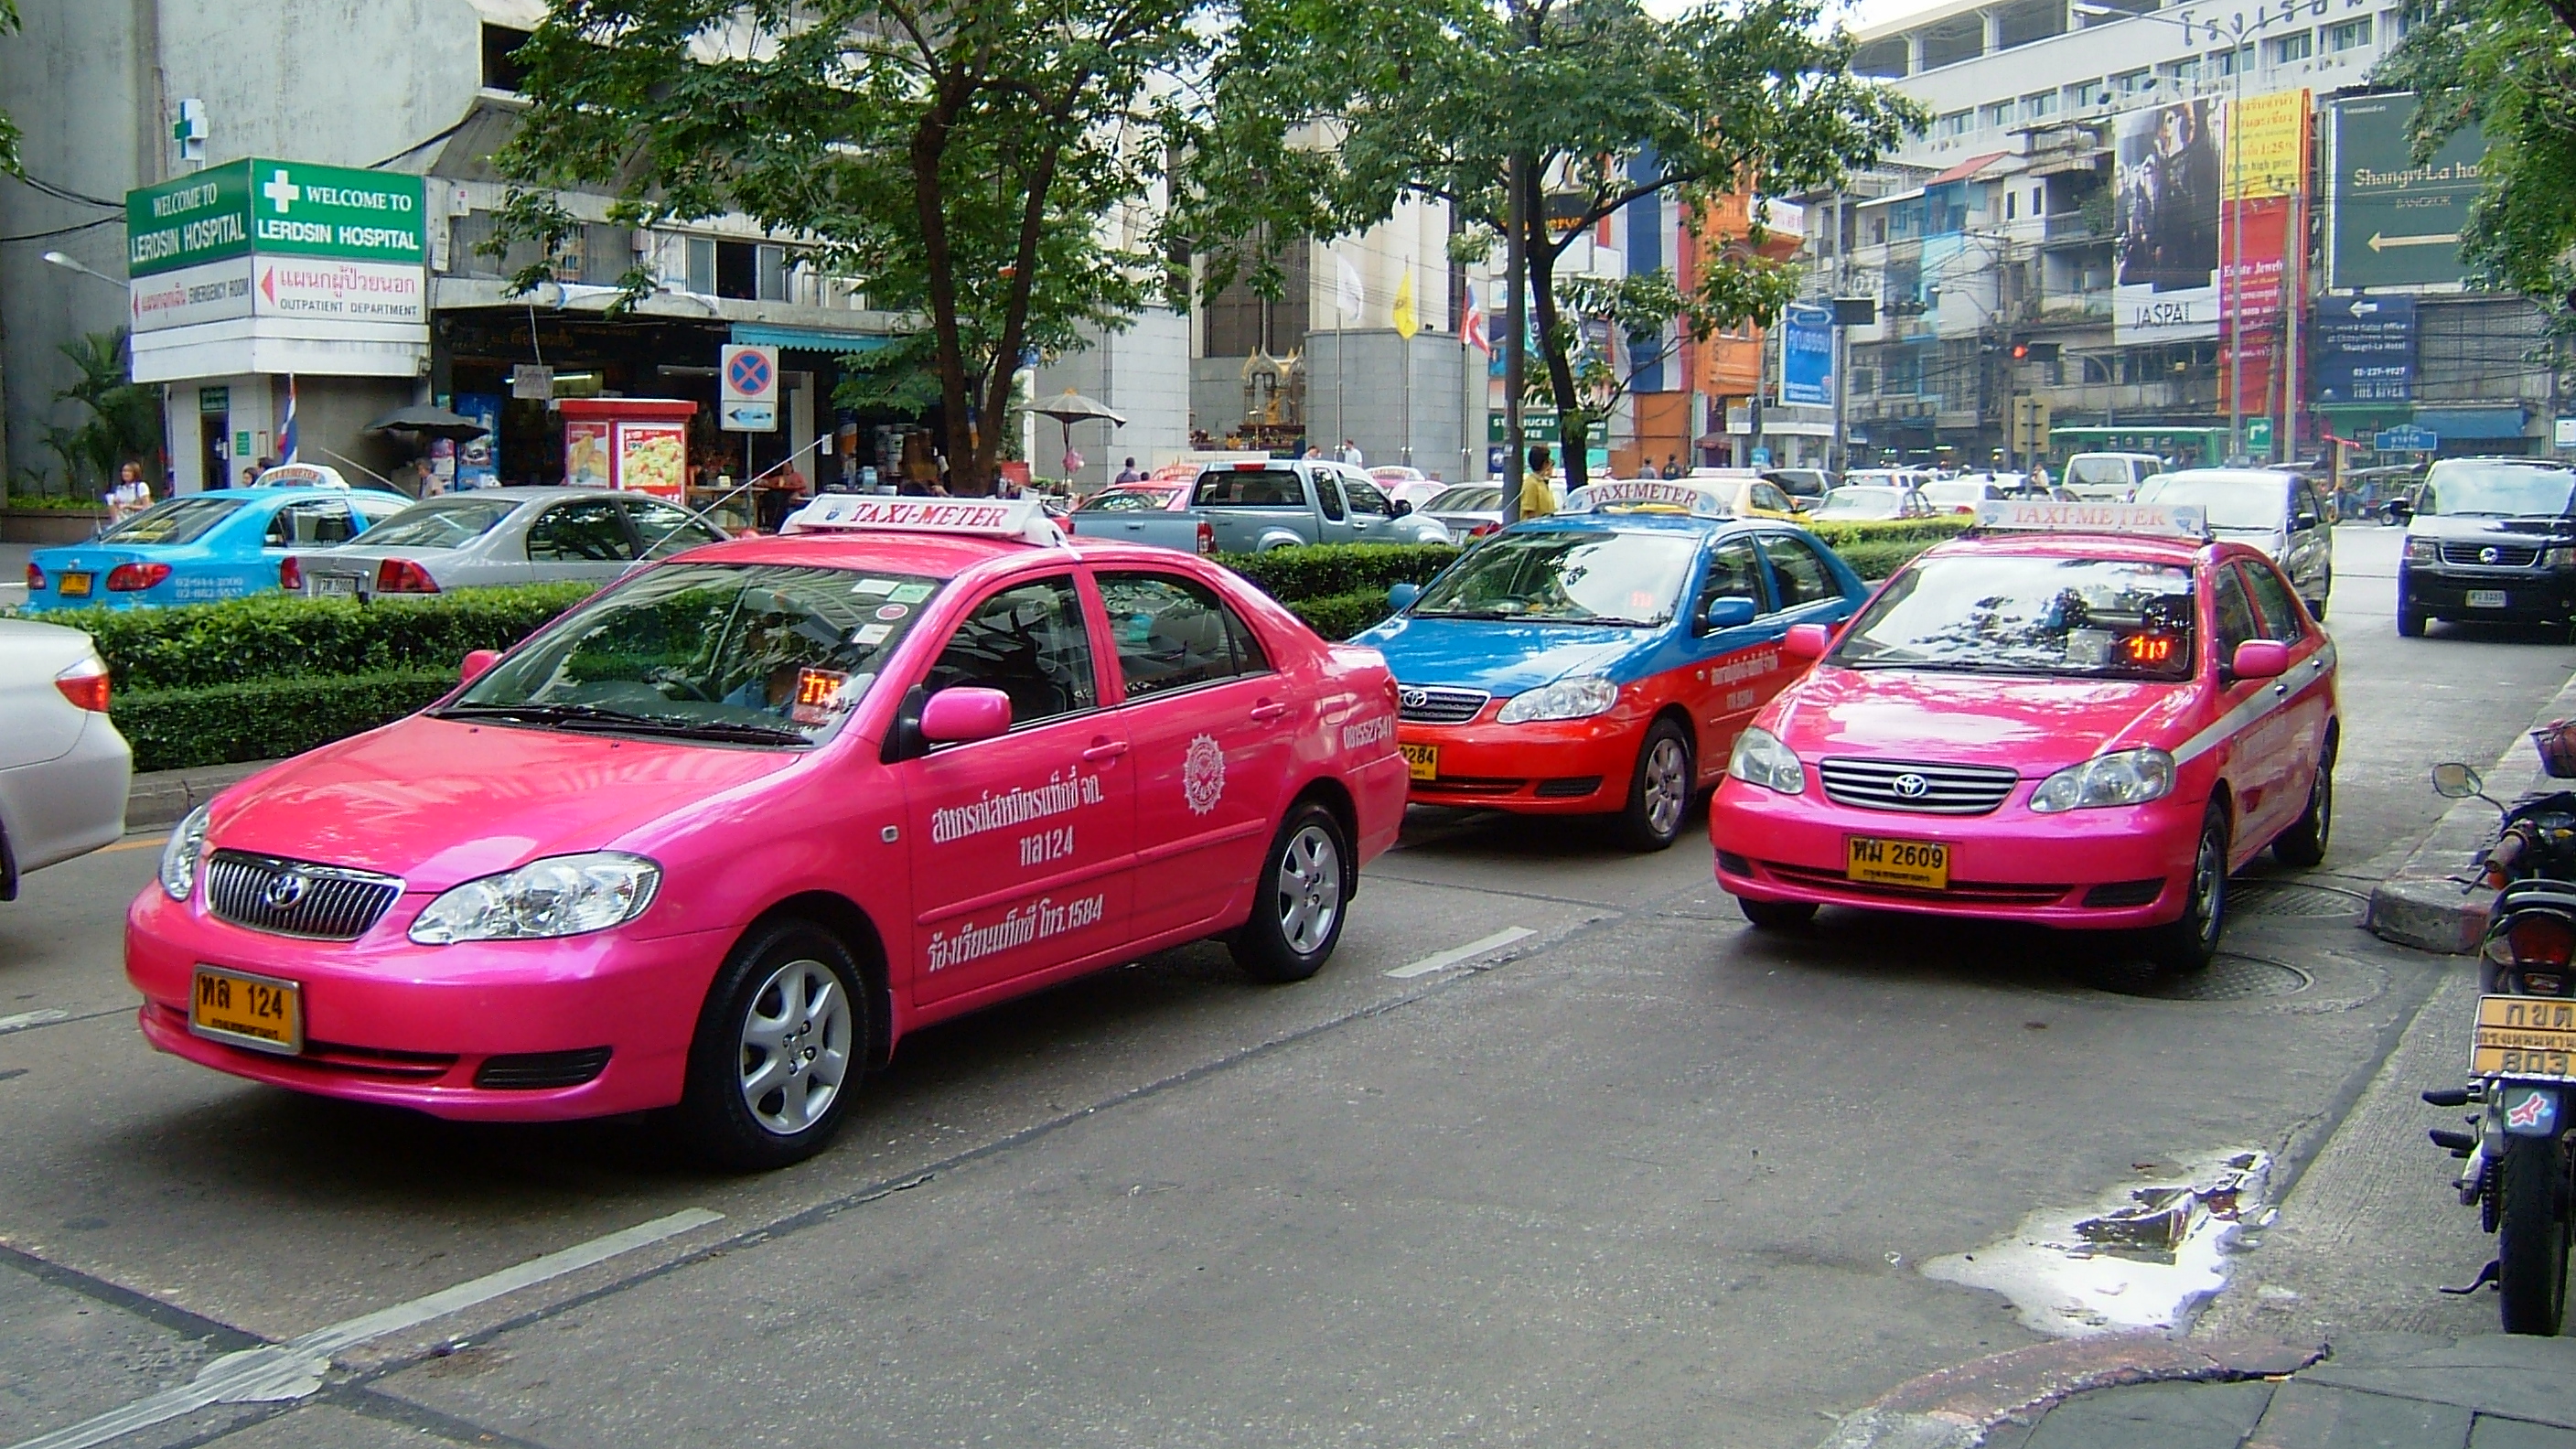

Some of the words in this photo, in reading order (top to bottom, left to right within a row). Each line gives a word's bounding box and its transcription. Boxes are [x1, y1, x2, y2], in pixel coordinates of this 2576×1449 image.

[2354, 163, 2451, 188] Shangri-La
[154, 186, 200, 219] WELCOME
[201, 182, 218, 206] TO
[306, 185, 388, 210] WELCOME
[389, 194, 413, 211] TO
[131, 227, 180, 263] LERDSIN
[184, 212, 246, 252] HOSPITAL
[258, 219, 332, 244] LERDSIN
[339, 226, 420, 251] HOSPITAL
[188, 282, 227, 305] EMERGENCY
[281, 265, 415, 298] แผนกผู้ป่วยนอก
[280, 298, 344, 313] OUTPATIENT
[351, 302, 418, 317] DEPARTMENT
[850, 502, 1009, 528] TAXI-METER
[2013, 505, 2167, 527] TAXI-METER
[931, 765, 1079, 844] สหกรณ์สหมิตรแท็กซี่
[1891, 843, 1944, 869] 2609
[248, 984, 284, 1020] 124
[2501, 1050, 2569, 1075] 803
